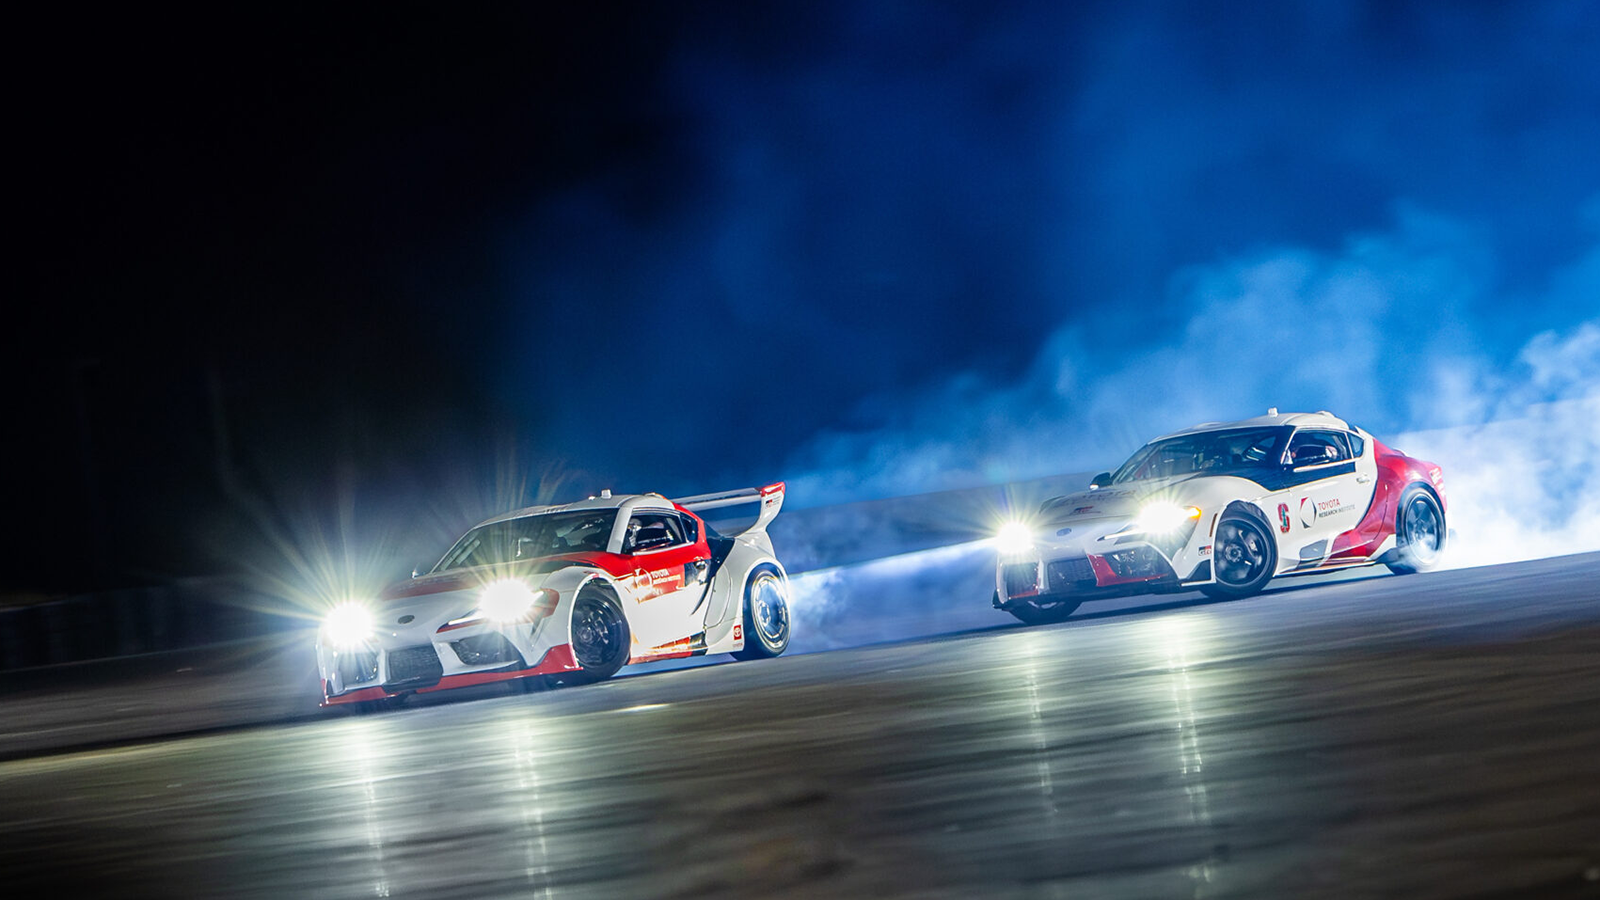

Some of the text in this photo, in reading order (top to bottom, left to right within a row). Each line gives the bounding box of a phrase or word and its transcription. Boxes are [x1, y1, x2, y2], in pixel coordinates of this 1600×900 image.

[1317, 498, 1341, 511] TOYOTA
[1277, 502, 1291, 533] S
[1318, 509, 1338, 518] RESEARCH
